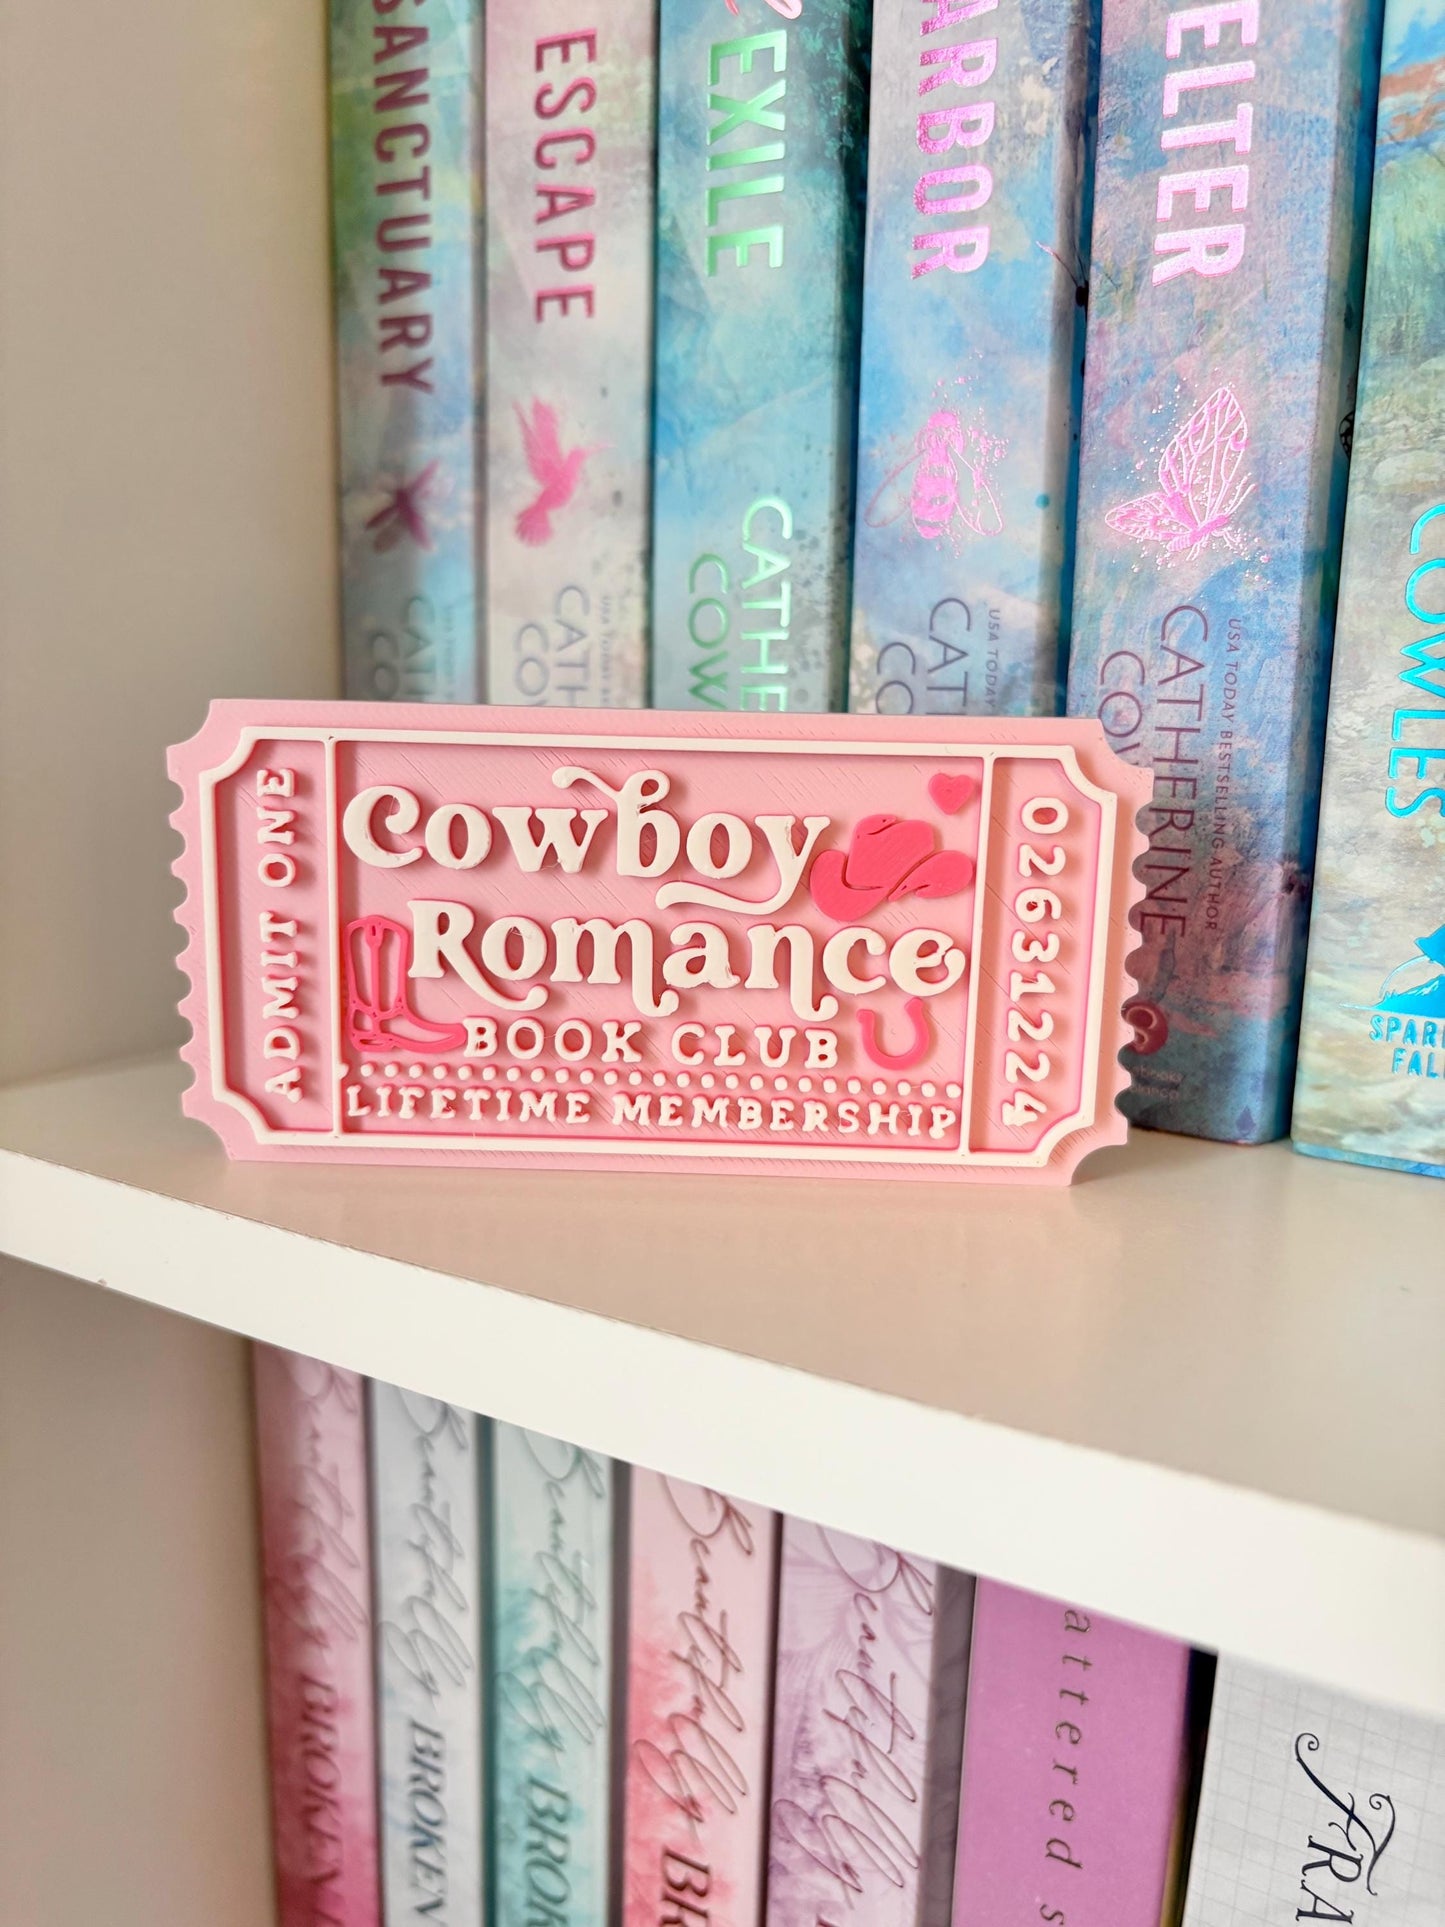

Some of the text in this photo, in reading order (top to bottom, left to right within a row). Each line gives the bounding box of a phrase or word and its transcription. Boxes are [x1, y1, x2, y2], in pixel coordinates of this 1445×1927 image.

[533, 28, 598, 324] ESCAPE
[706, 29, 788, 278] EXILE
[1152, 0, 1260, 287] ELTER
[514, 623, 551, 705] CO
[688, 553, 730, 709] COW
[741, 498, 793, 711] CATHE
[925, 598, 971, 715] CAT
[986, 609, 1000, 709] USA TODAY
[343, 766, 831, 915] Cowboy
[1139, 605, 1208, 938] CATHERINE
[1205, 618, 1241, 931] USA TODAY BESTSELLING AUTHOR
[256, 768, 301, 1104] ADMIT ONE
[407, 899, 966, 1022] Romance
[1002, 797, 1068, 1127] 02631224
[1369, 1014, 1445, 1049] SPAR
[347, 1084, 957, 1139] LIFETIME MEMBERSHIP
[462, 1016, 838, 1069] BOOK CLUB
[1391, 1048, 1445, 1079] FAL
[408, 1718, 448, 1927] BROKEN
[1044, 1608, 1093, 1870] attered
[1295, 1732, 1396, 1924] FRA
